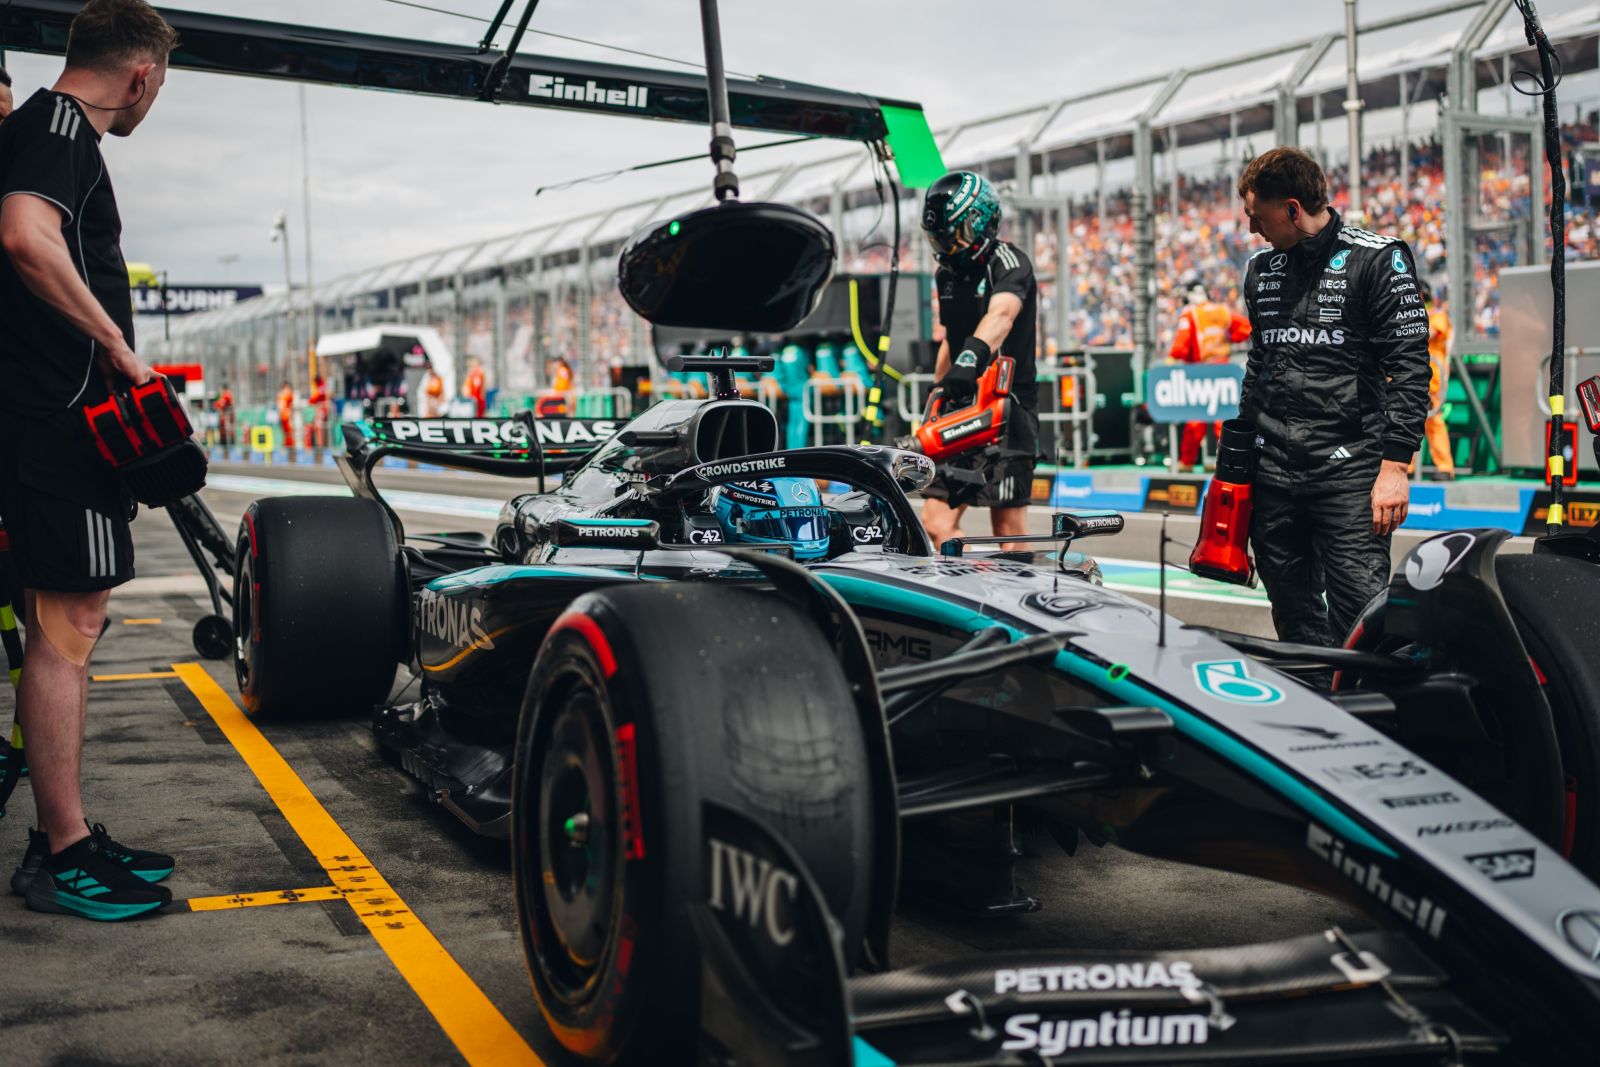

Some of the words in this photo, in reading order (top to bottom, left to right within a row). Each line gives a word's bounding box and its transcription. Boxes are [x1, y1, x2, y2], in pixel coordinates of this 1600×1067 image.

[529, 74, 648, 108] Einhell
[1265, 281, 1281, 290] UBS
[131, 288, 238, 311] LBOURNE
[1400, 294, 1420, 305] IWC
[1396, 309, 1420, 320] AMD
[1154, 369, 1240, 416] allwyn
[943, 419, 982, 440] Einhell
[699, 457, 786, 478] CROWDSTRIKE
[733, 491, 777, 506] CROWDSTRIKE
[780, 508, 825, 518] PETRONAS
[1087, 517, 1120, 528] PETRONAS
[578, 528, 639, 537] PETRONAS
[853, 526, 884, 543] G42
[709, 837, 798, 946] IWC
[1306, 822, 1447, 940] Einhell
[995, 961, 1195, 994] PETRONAS
[1001, 1009, 1209, 1057] Syntium
